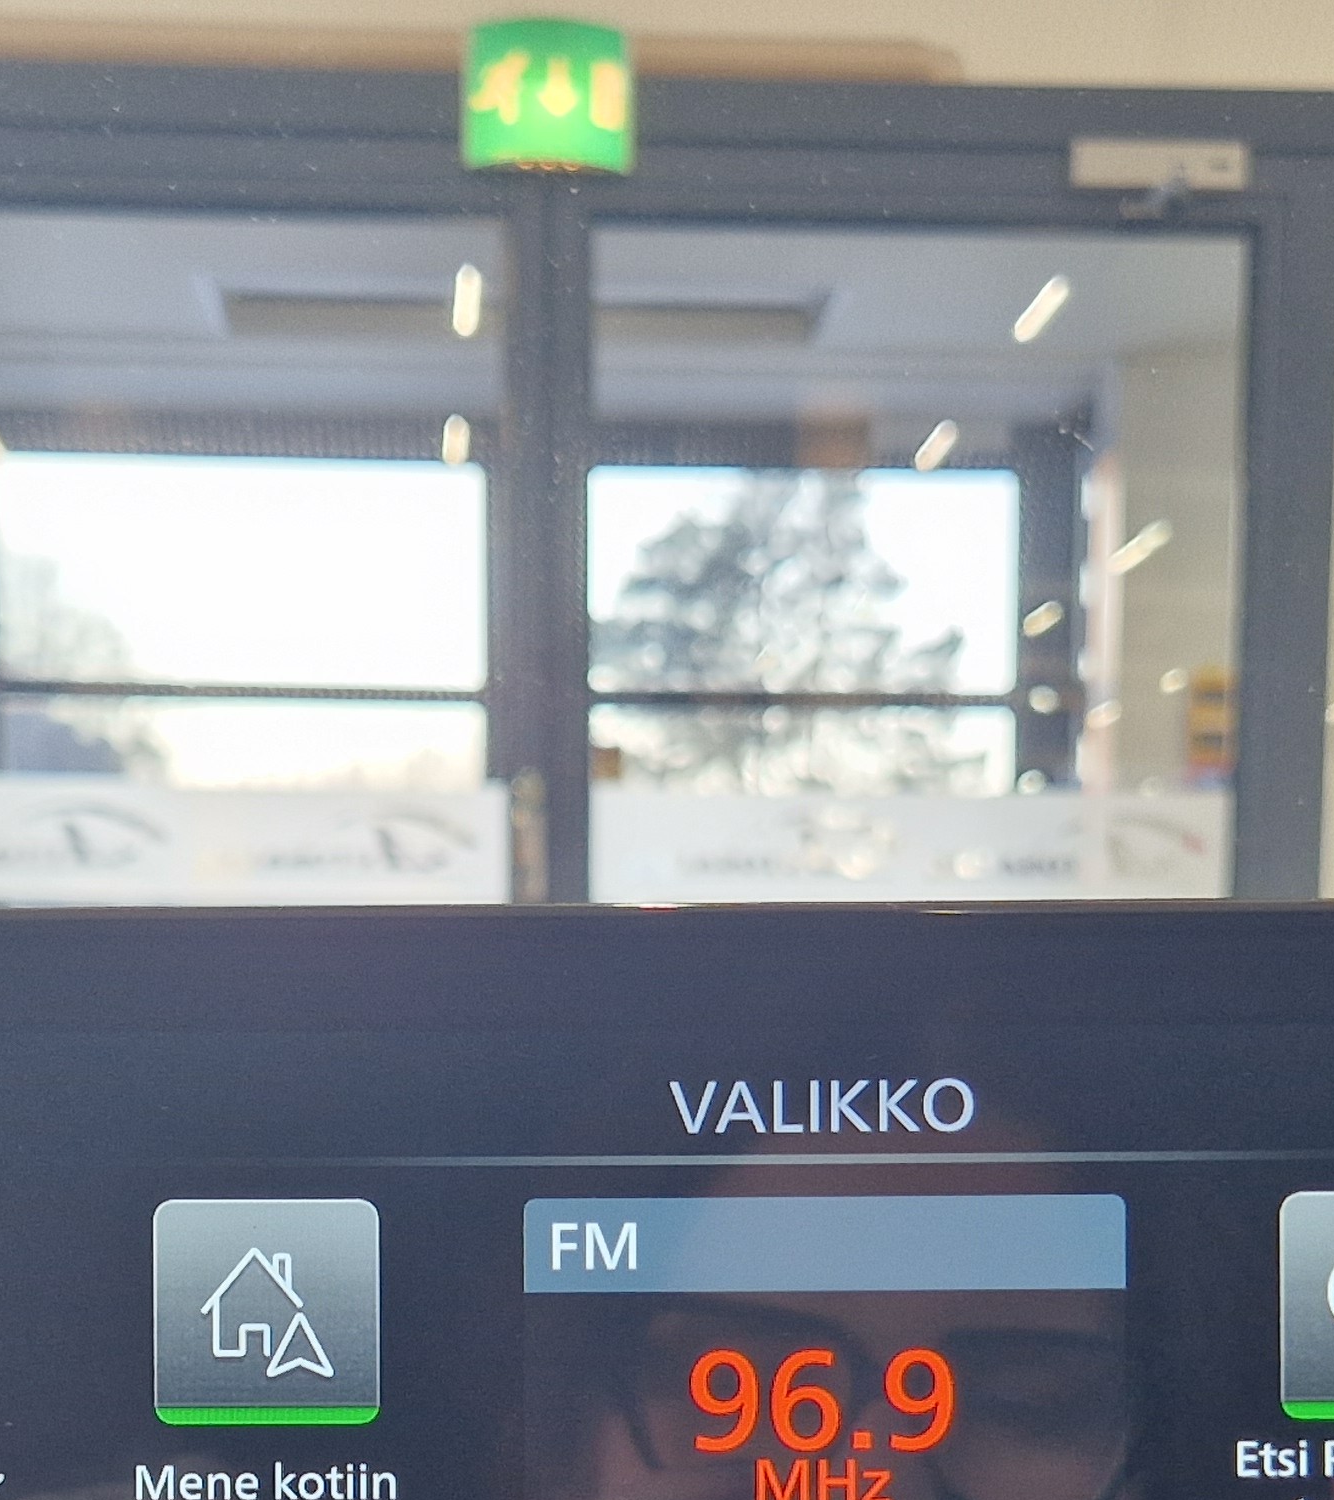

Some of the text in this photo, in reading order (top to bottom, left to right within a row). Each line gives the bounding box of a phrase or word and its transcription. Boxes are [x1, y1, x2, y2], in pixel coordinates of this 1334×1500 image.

[670, 1077, 975, 1135] VALIKKO
[550, 1222, 639, 1271] FM
[688, 1347, 957, 1453] 96.9
[1235, 1439, 1309, 1479] Etsi
